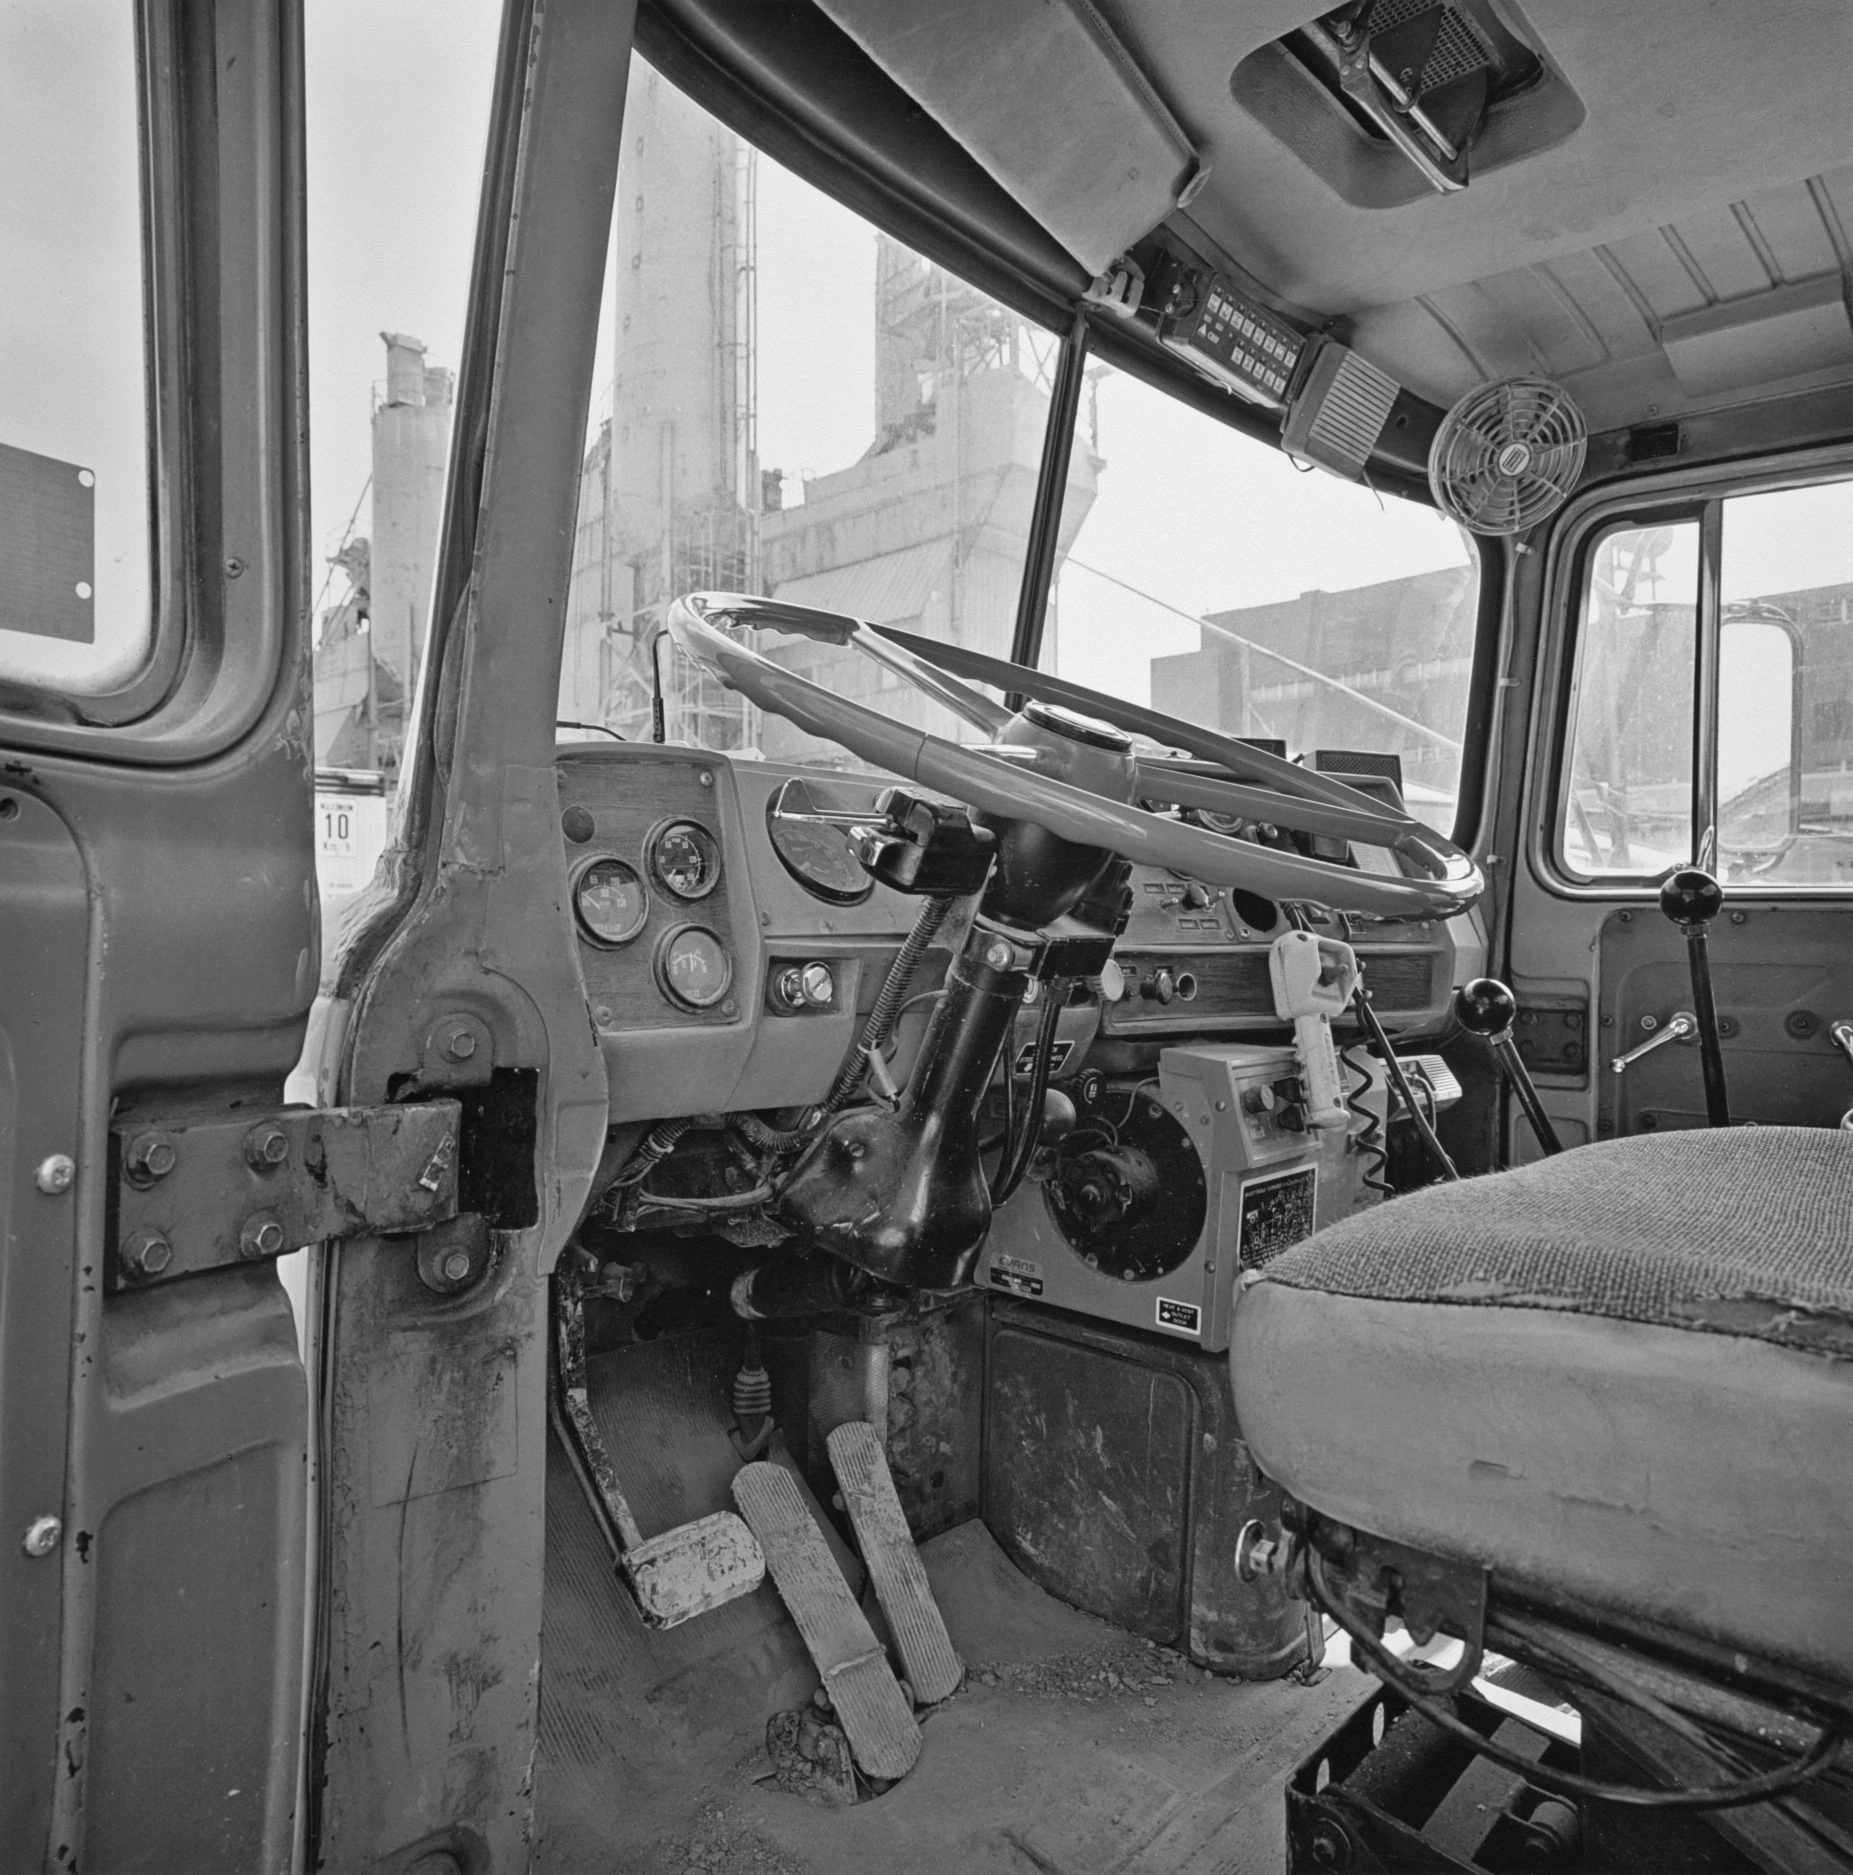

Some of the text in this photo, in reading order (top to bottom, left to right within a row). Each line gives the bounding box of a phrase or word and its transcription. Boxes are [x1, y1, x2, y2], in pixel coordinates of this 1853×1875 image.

[325, 814, 349, 839] 10
[999, 1256, 1036, 1273] EVANS
[1171, 1311, 1191, 1320] OUTLET
